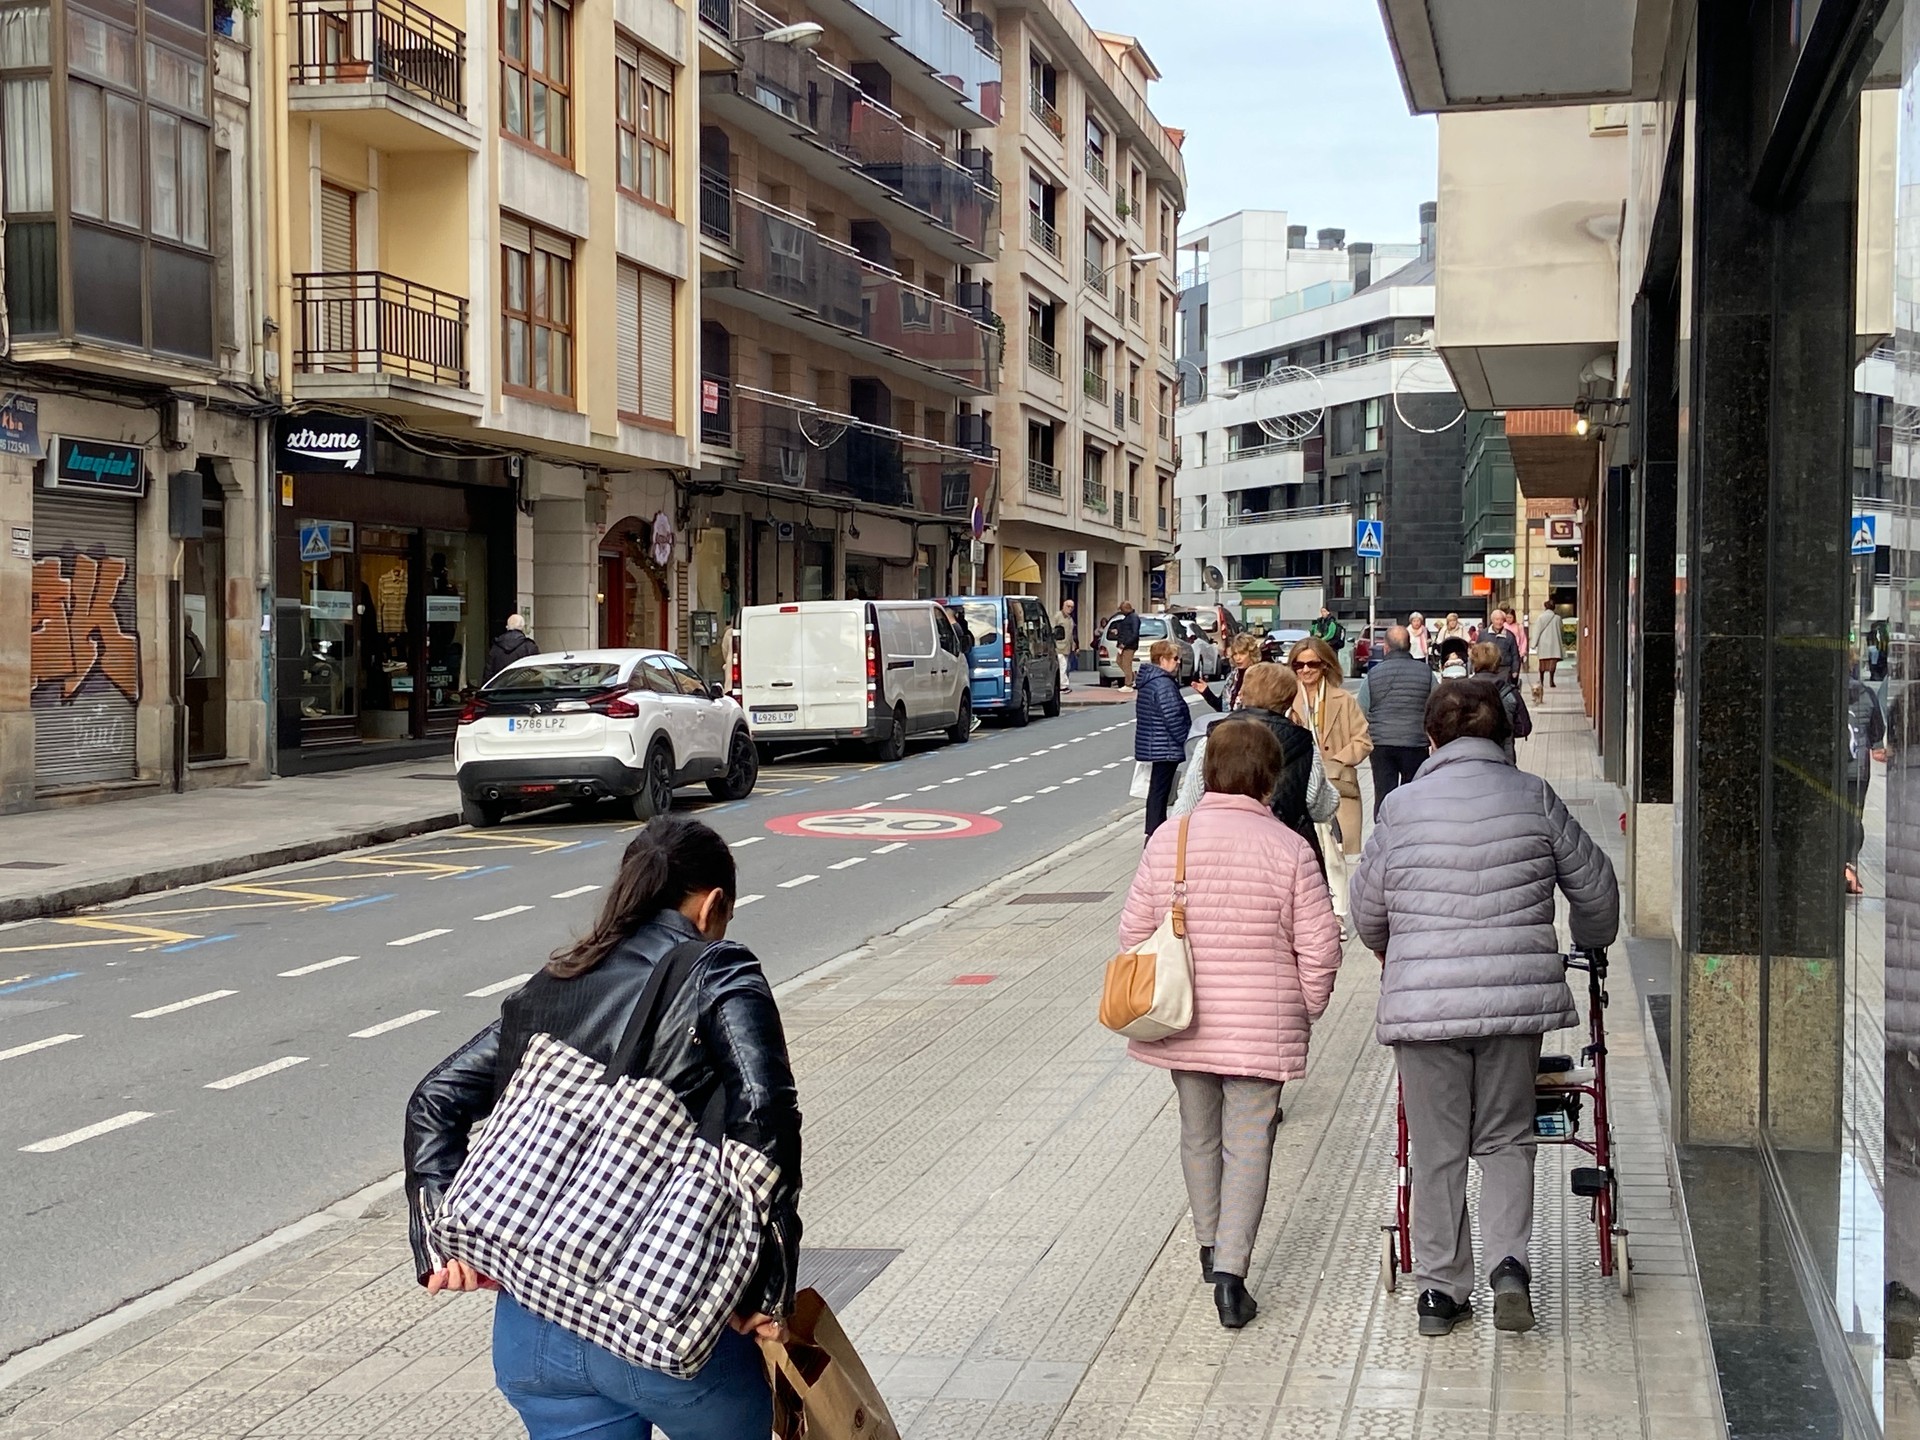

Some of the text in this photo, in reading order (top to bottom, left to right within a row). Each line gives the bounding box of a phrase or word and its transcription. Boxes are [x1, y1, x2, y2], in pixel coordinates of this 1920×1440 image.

[287, 428, 361, 448] xtreme
[67, 444, 135, 482] begiak
[516, 718, 565, 729] 5786 LPZ
[758, 713, 777, 721] 4926
[807, 816, 957, 831] 20
